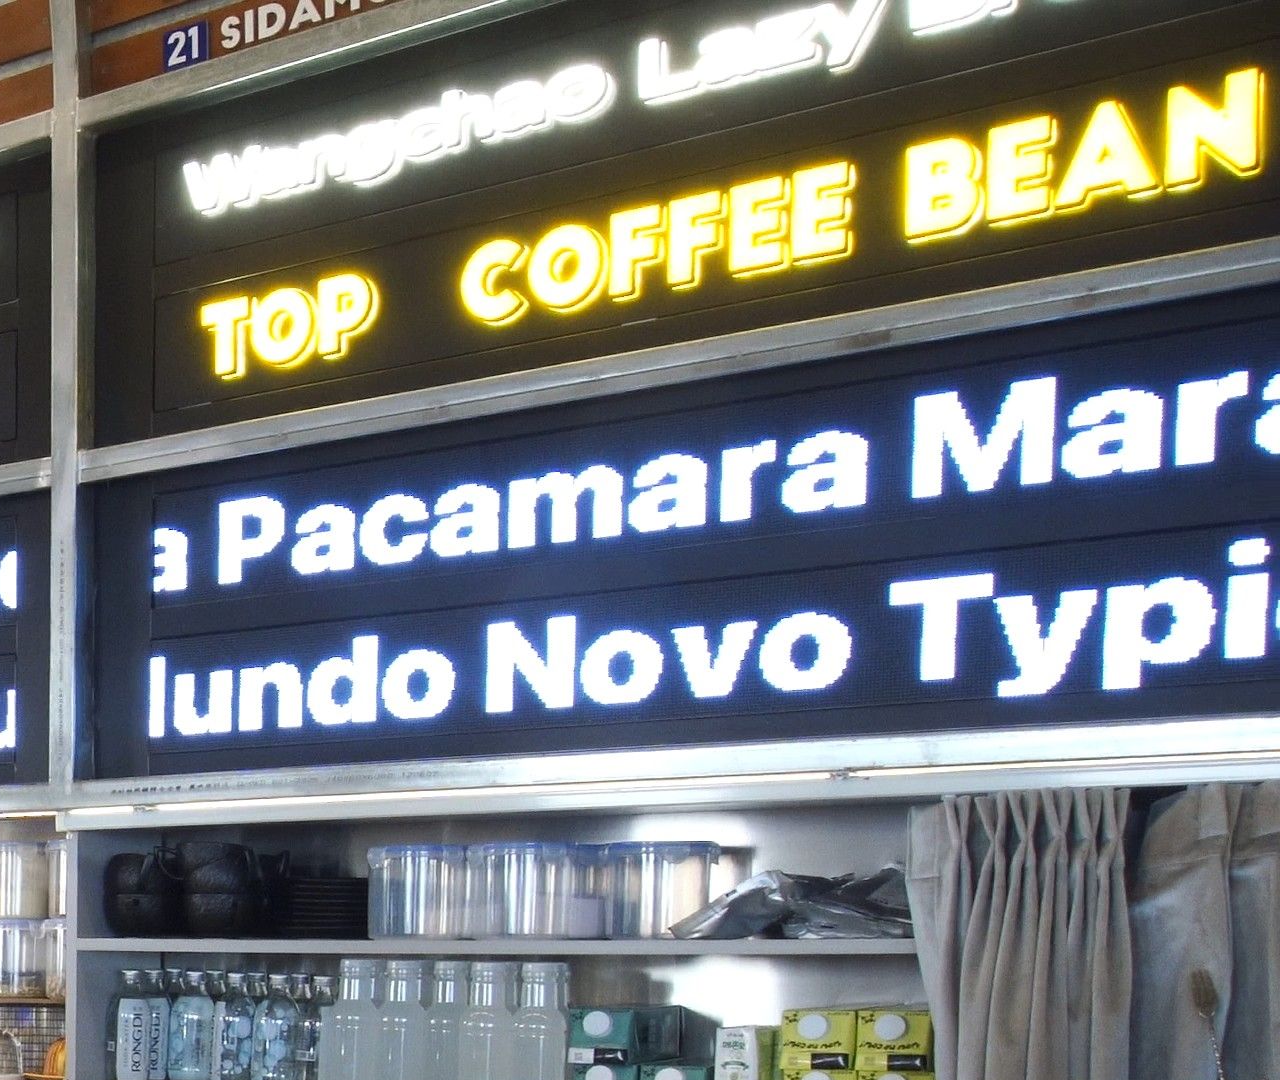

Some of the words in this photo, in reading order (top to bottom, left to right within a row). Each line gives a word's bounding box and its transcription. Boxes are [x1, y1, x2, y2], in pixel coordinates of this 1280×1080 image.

[167, 25, 199, 67] 21
[220, 0, 386, 49] SIDA
[181, 64, 614, 218] Wangchao
[638, 0, 882, 104] Lazy
[197, 270, 378, 380] TOP
[460, 161, 858, 328] COFFEE
[904, 66, 1265, 246] BEAN
[216, 426, 870, 586] Pacamara
[485, 609, 853, 717] Novo
[888, 536, 1280, 698] Typi
